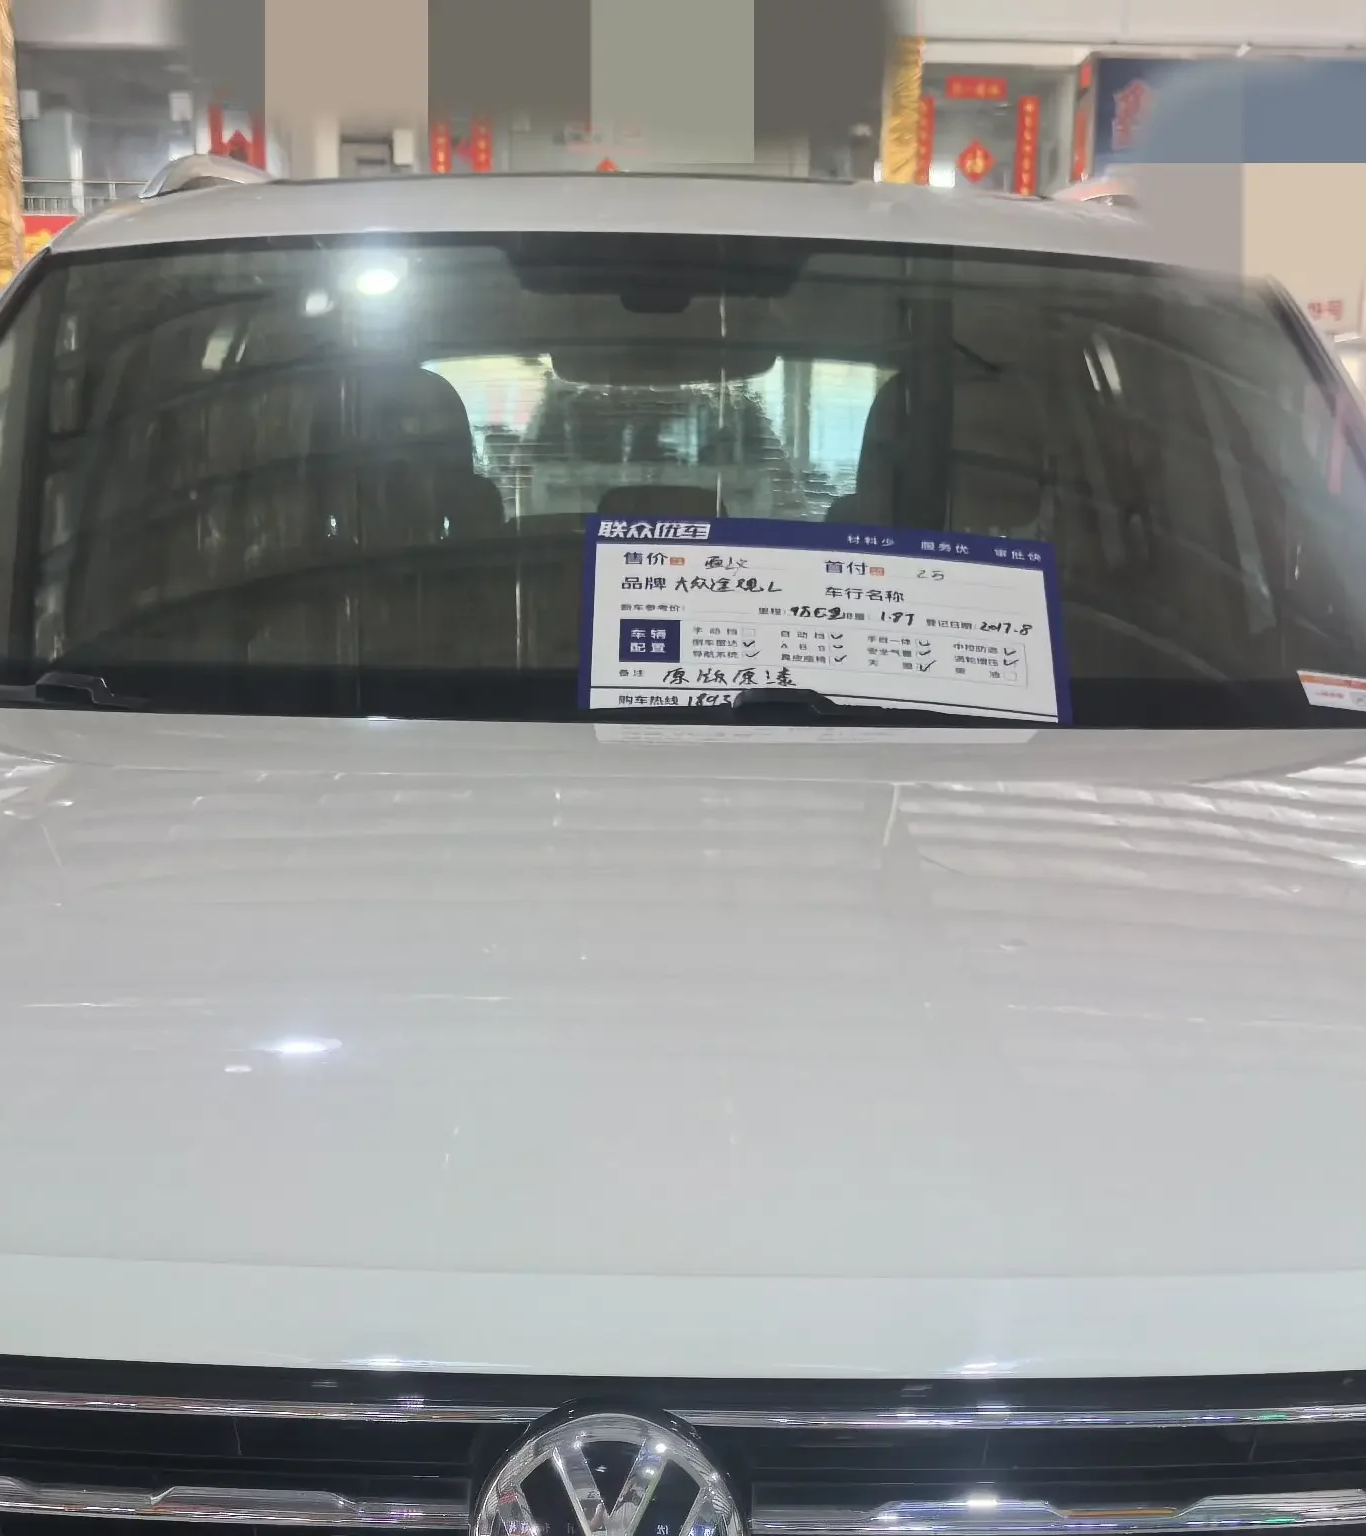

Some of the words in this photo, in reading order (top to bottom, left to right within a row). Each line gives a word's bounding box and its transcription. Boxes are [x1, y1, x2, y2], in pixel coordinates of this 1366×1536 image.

[597, 521, 711, 540] 联众优车
[846, 534, 895, 547] 材料少
[920, 541, 970, 555] 服务优
[994, 548, 1042, 562] 审批快
[623, 551, 669, 566] 售价
[824, 560, 868, 576] 首付
[621, 576, 667, 591] 品牌
[824, 586, 905, 603] 车行名称
[630, 628, 667, 640] 车辆
[630, 642, 666, 654] 配置
[618, 695, 679, 707] 购车热线
